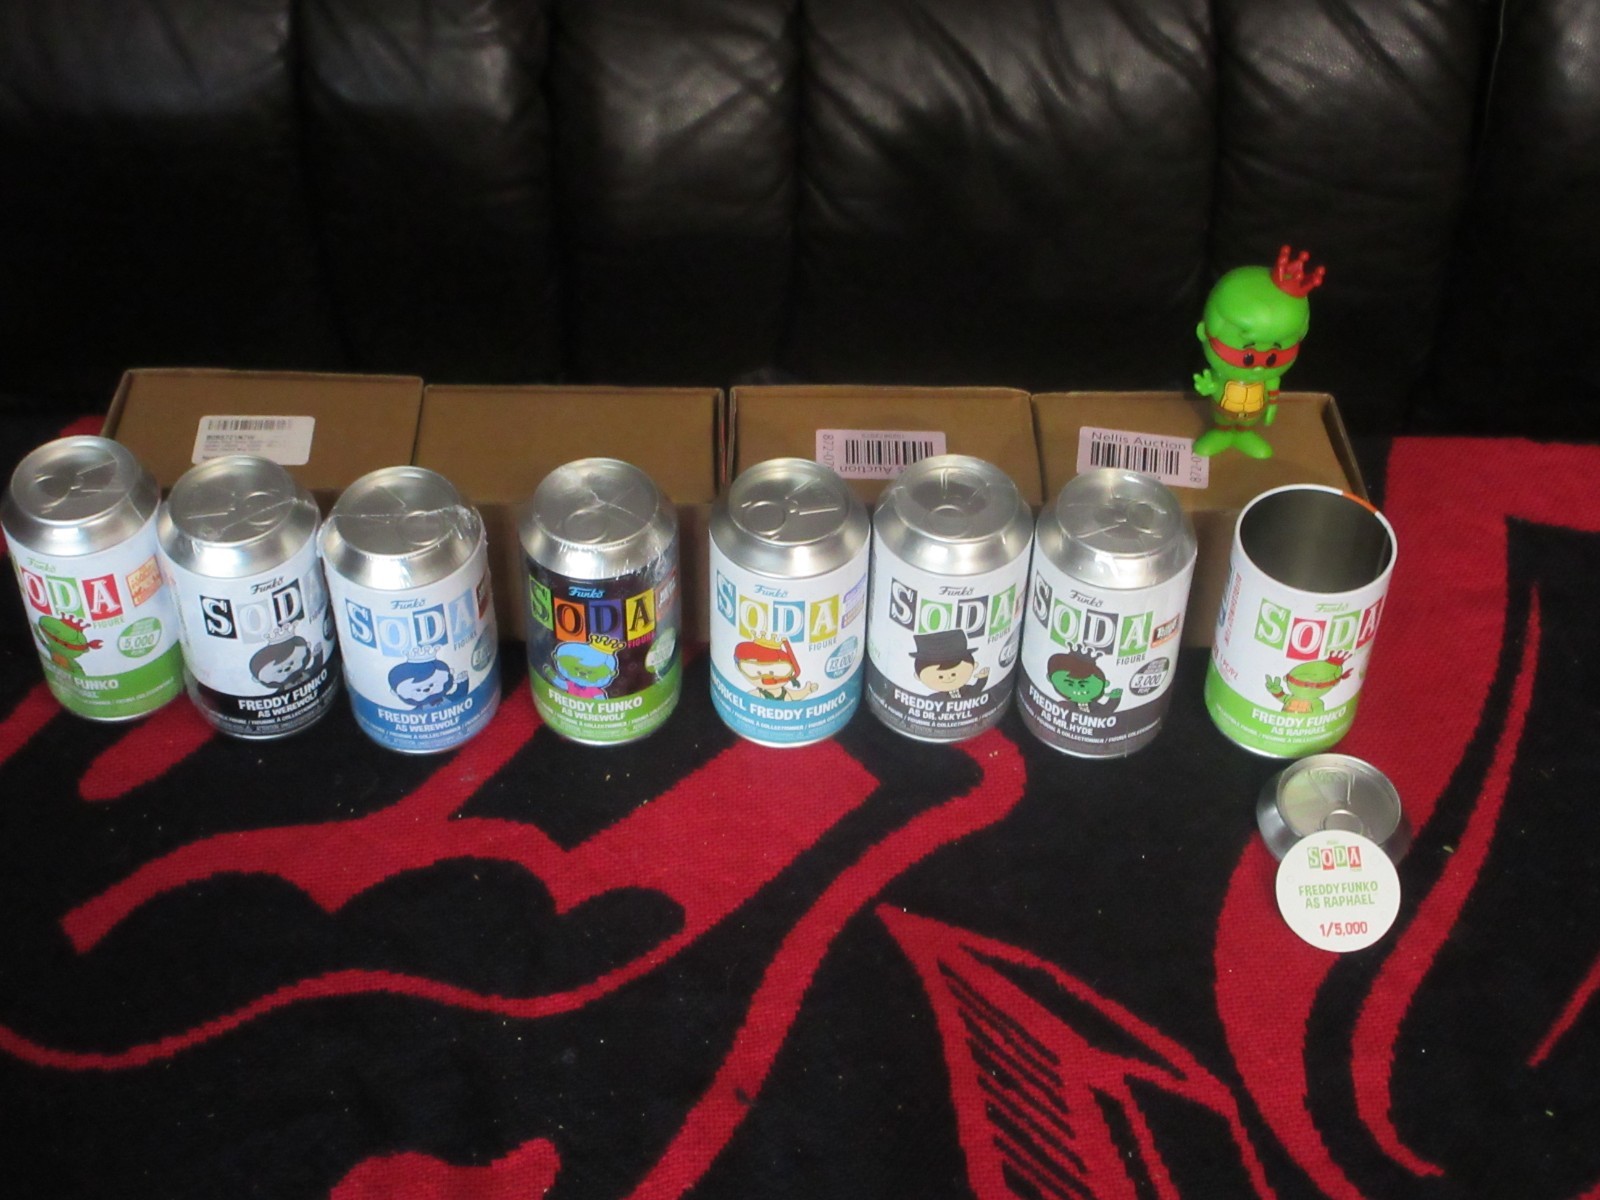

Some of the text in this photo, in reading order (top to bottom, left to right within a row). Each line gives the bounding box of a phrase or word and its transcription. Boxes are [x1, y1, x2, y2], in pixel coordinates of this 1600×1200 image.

[1091, 431, 1186, 451] Nellis Auction
[839, 465, 893, 475] Auction
[1190, 452, 1202, 483] 872-0
[20, 566, 124, 621] ODA
[252, 576, 284, 595] Funko
[568, 586, 605, 599] Funko
[754, 584, 788, 598] Funko
[939, 585, 975, 597] Funko
[390, 598, 425, 610] Funko
[529, 574, 656, 642] SODA
[717, 569, 840, 643] SODA
[889, 577, 1016, 639] SODA
[1070, 590, 1104, 608] Funko
[345, 588, 476, 658] SODA
[1033, 572, 1154, 658] SODA
[1254, 595, 1386, 661] SODA
[1116, 653, 1146, 666] FIGURE
[74, 677, 119, 690] FUNKO
[238, 692, 290, 711] FREDDY
[292, 668, 327, 700] FUNKO
[1134, 674, 1162, 688] 3,000
[257, 710, 271, 718] AS
[272, 690, 318, 716] WEREWOLF
[377, 708, 428, 724] FREDDY
[430, 697, 473, 722] FUNKO
[548, 688, 594, 713] FREDDY
[597, 696, 643, 714] FUNKO
[749, 703, 803, 720] FREDDY
[806, 691, 846, 718] FUNKO
[894, 689, 944, 712] FREDDY
[946, 693, 989, 713] FUNKO
[1029, 684, 1070, 719] FREDDY
[1071, 711, 1117, 729] FUNKO
[395, 724, 408, 732] AS
[409, 716, 460, 732] WEREWOLF
[561, 707, 573, 717] AS
[574, 711, 626, 722] WEREWOLF
[908, 707, 972, 721] AS DR. JEKYLL
[1040, 710, 1052, 722] AS
[1069, 724, 1093, 736] HYDE
[1252, 708, 1303, 728] FREDDY
[1306, 706, 1347, 726] FUNKO
[1271, 725, 1326, 737] AS RAPHAEL
[1307, 845, 1361, 871] SODA
[1298, 881, 1379, 896] FREDDY FUNKO
[1305, 894, 1376, 909] AS RAPHAEL
[1319, 921, 1368, 937] 1/5,000
